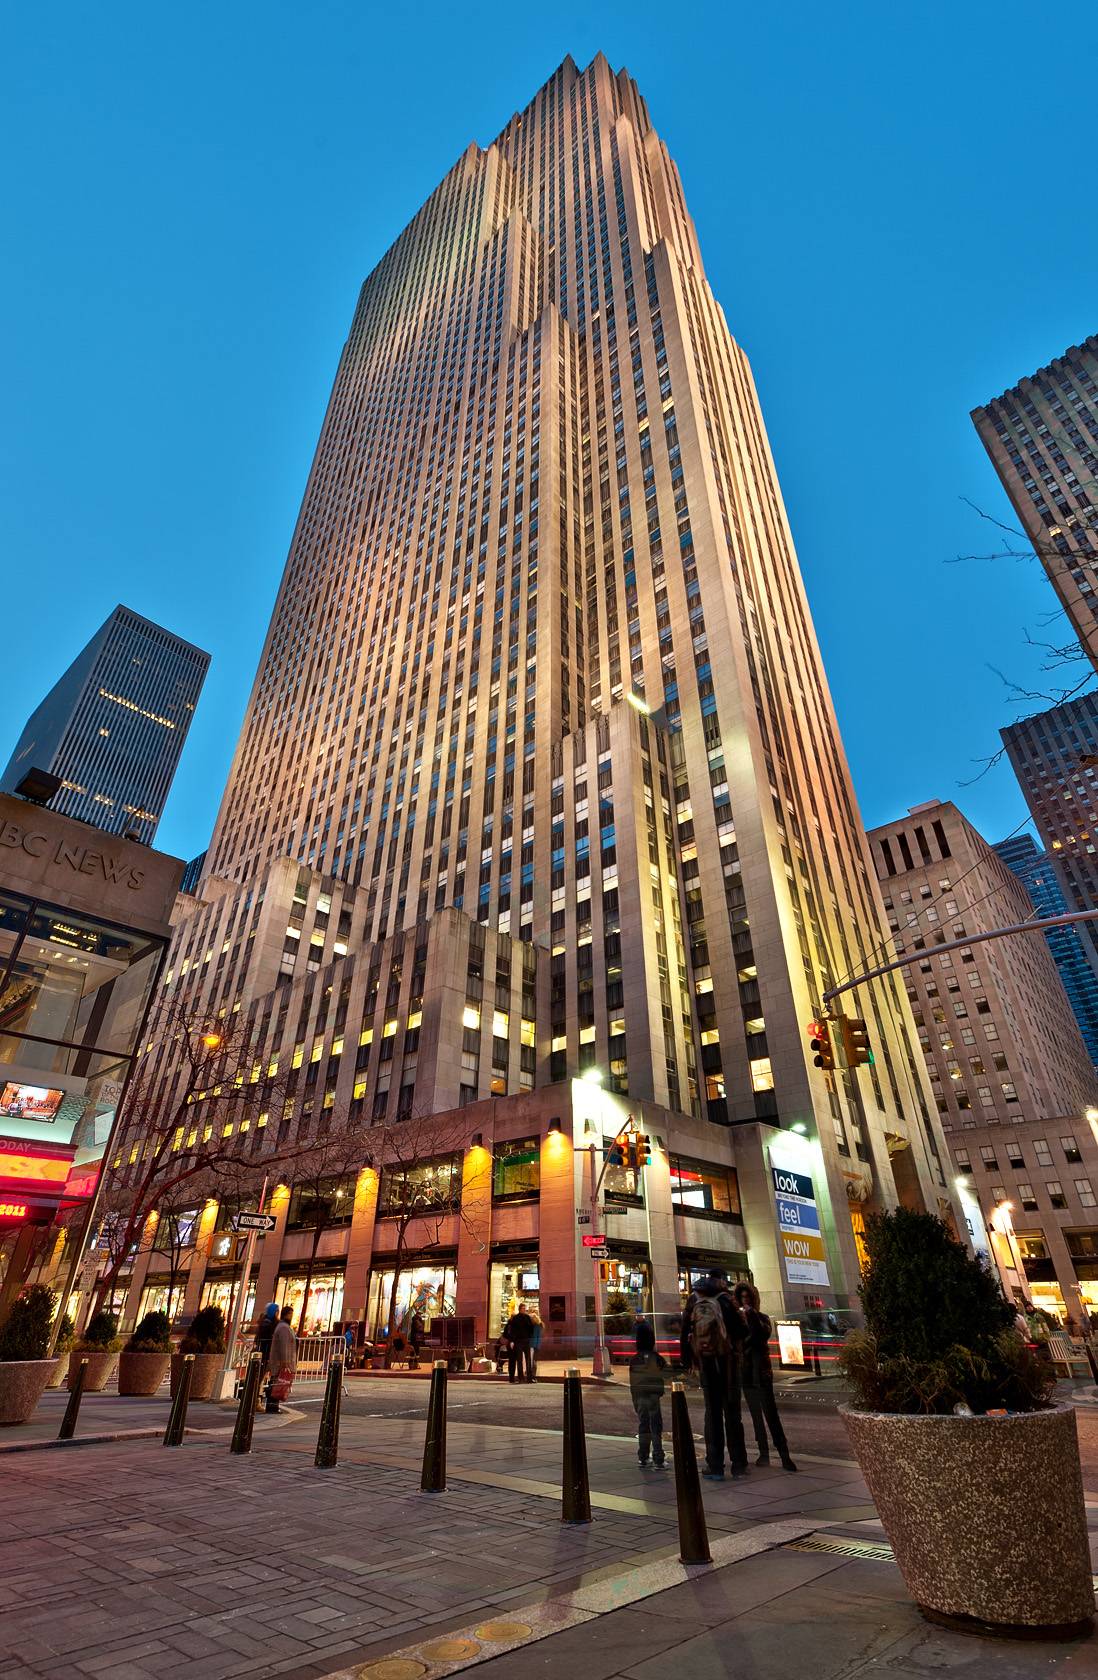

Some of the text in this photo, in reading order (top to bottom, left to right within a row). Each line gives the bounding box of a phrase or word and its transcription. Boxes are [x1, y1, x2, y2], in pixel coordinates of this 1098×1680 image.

[53, 839, 145, 890] NEWS
[774, 1170, 799, 1194] look
[243, 1217, 271, 1227] ONE WAY
[780, 1202, 801, 1225] feel
